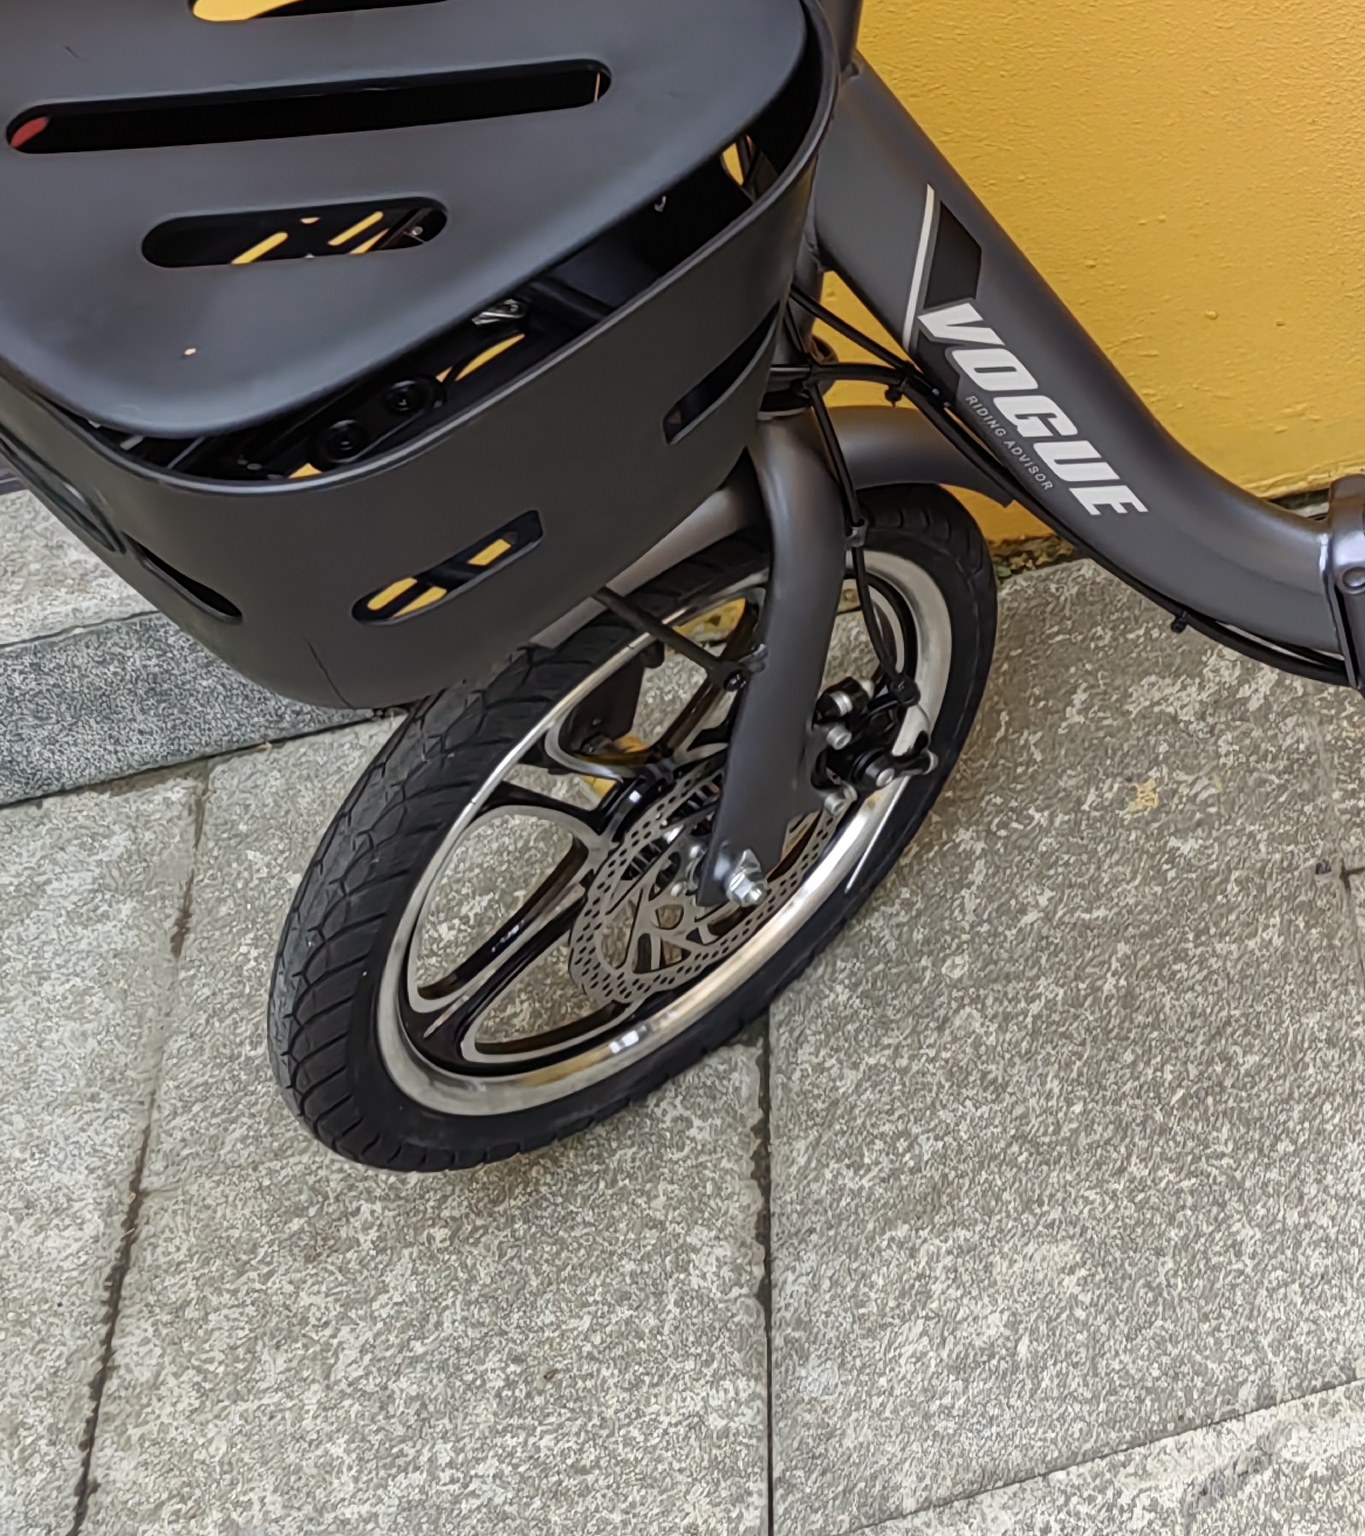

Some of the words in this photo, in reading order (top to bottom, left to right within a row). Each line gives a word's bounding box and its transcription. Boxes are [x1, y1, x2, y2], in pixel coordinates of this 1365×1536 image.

[917, 303, 1149, 516] VOGUE
[966, 396, 1006, 437] RIDING
[1004, 440, 1053, 490] ADVISOR
